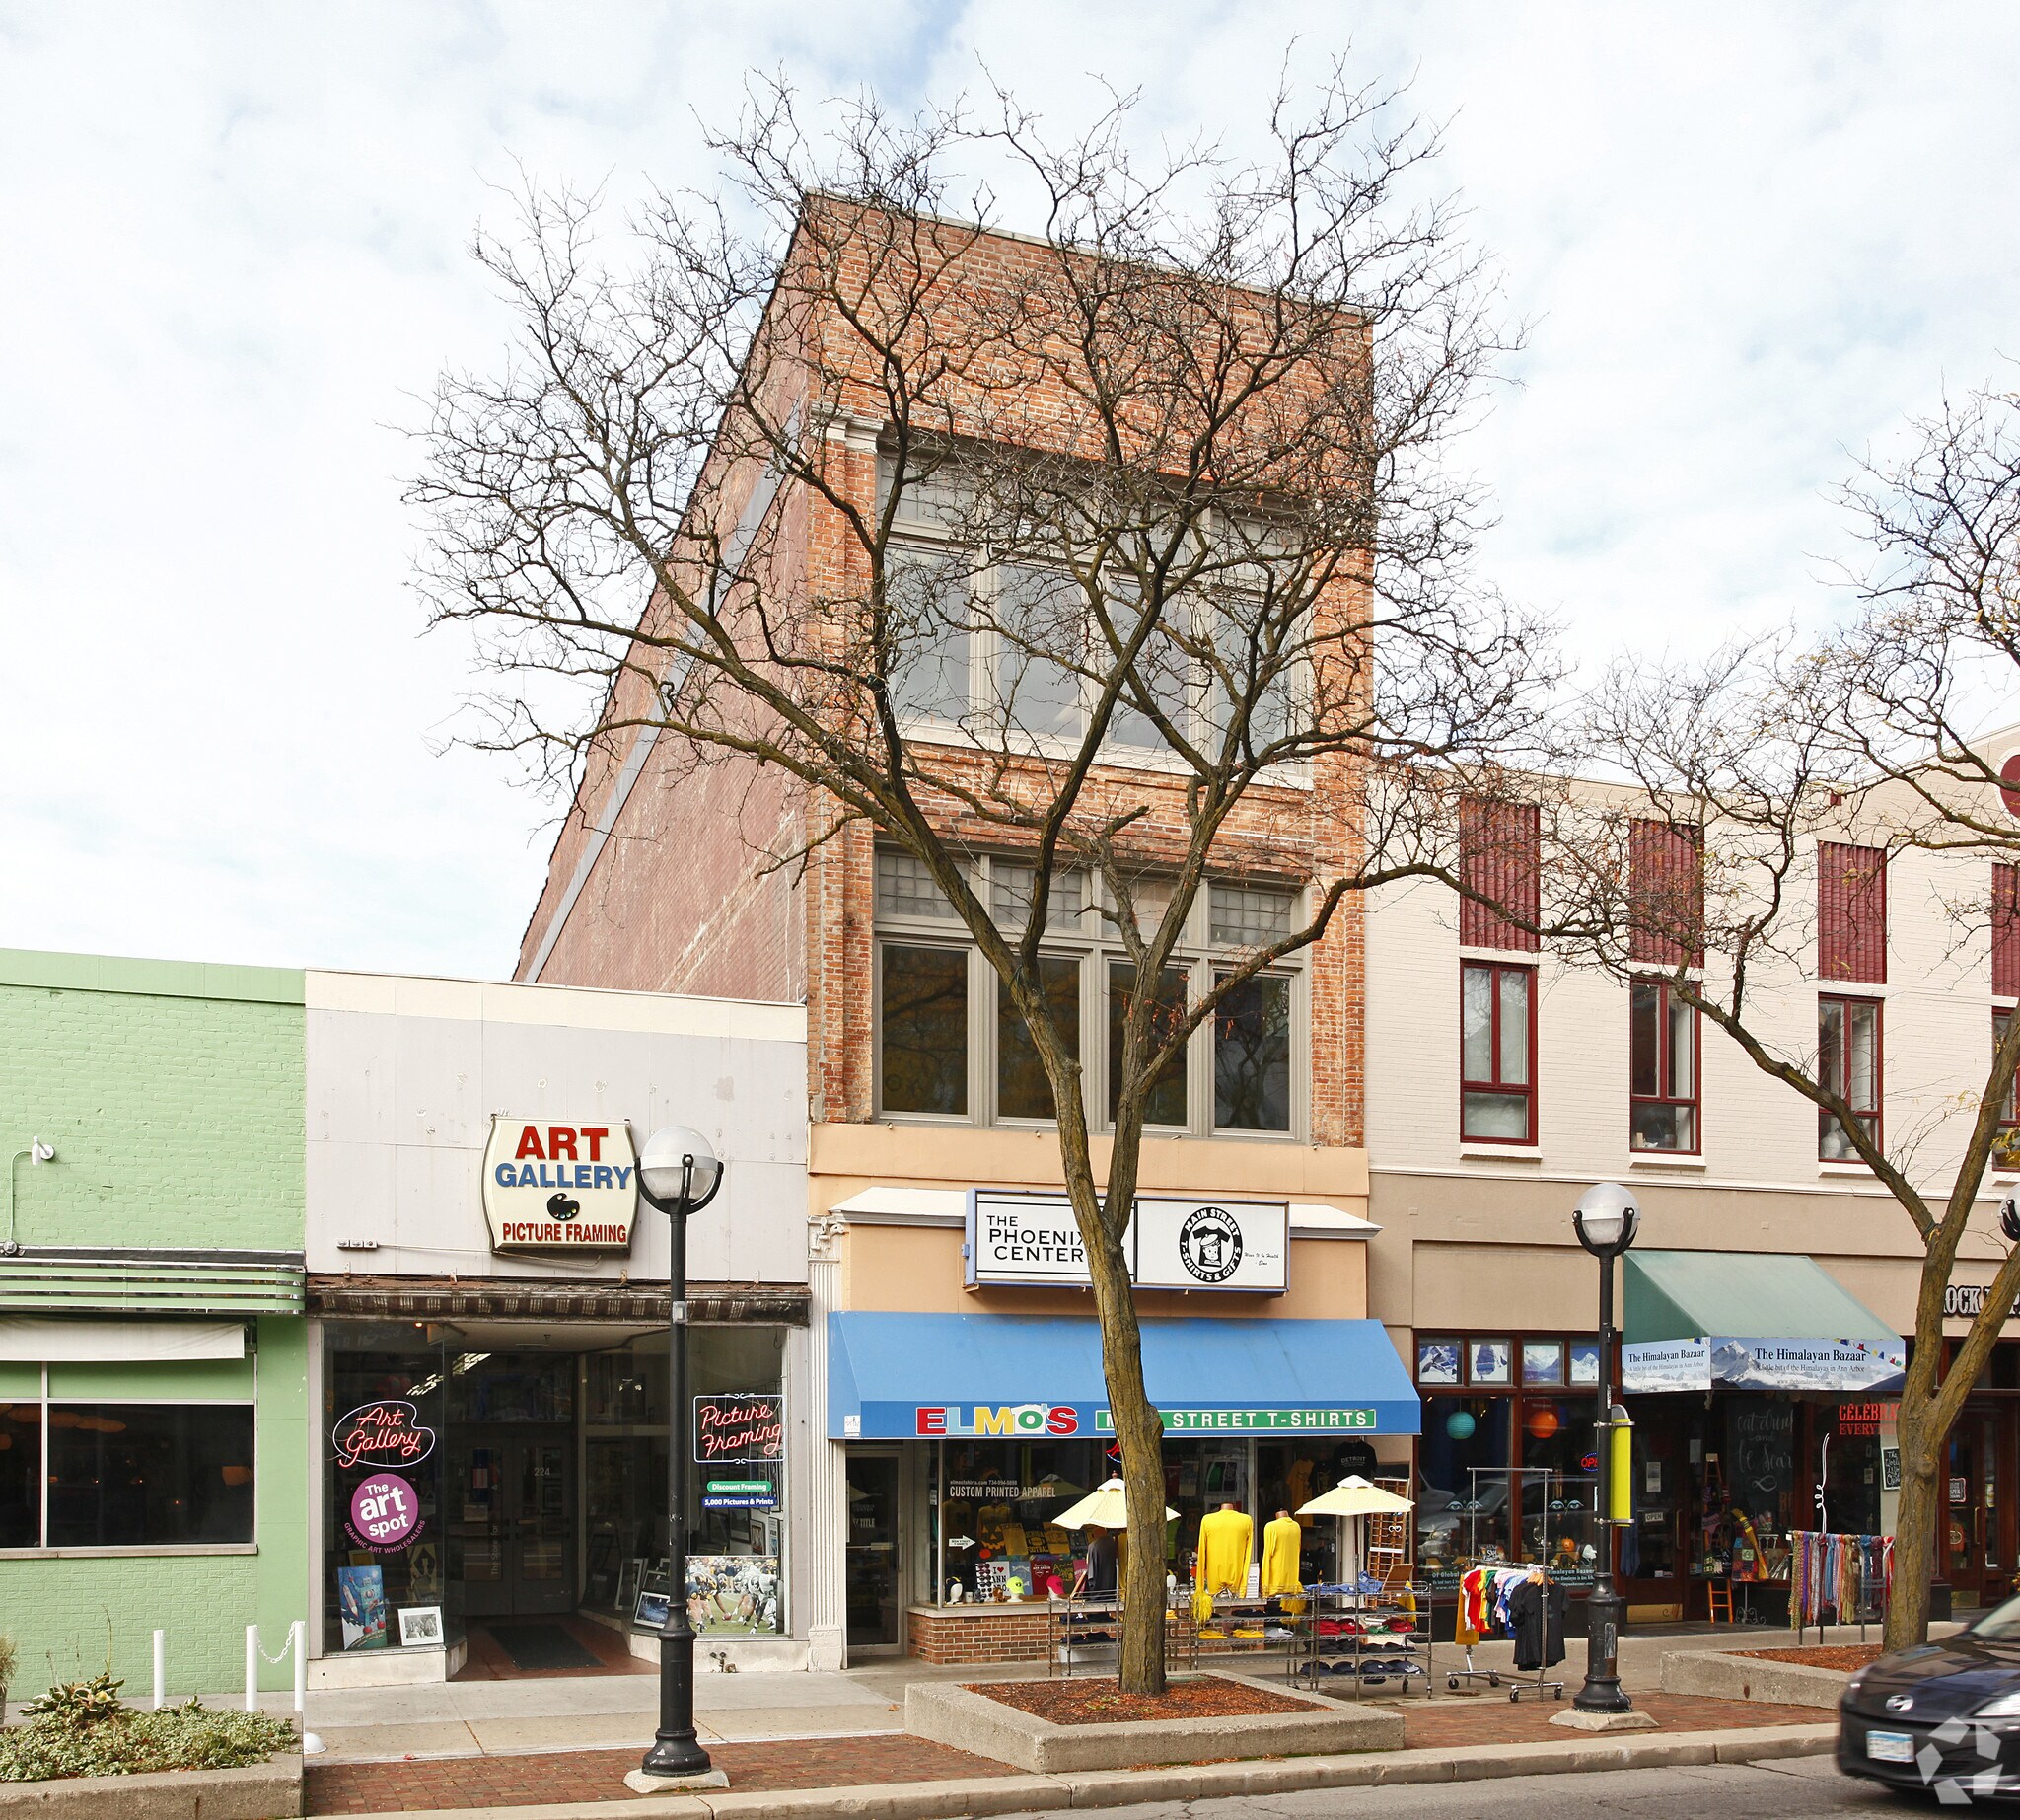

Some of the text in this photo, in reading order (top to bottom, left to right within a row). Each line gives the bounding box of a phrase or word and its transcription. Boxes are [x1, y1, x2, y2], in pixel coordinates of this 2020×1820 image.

[515, 1125, 608, 1161] ART
[495, 1163, 633, 1189] GALLERY
[503, 1223, 626, 1242] PICTURE FRAMING
[987, 1215, 1018, 1227] THE
[1184, 1209, 1239, 1236] MAIN STREET
[994, 1245, 1083, 1262] CENTER
[1181, 1240, 1241, 1281] T-SHIRTS & GIFTS
[1944, 1287, 1980, 1313] OCK
[1628, 1349, 1705, 1363] The Himalayan Bazaar
[1755, 1348, 1866, 1363] The Himalayan Bazaar
[356, 1406, 405, 1426] Art
[700, 1404, 773, 1430] Picture
[916, 1402, 1078, 1436] ELMO'S
[1173, 1412, 1367, 1428] STREET T-SHIRTS
[339, 1428, 422, 1468] Gallery
[702, 1424, 782, 1458] Framing
[534, 1467, 551, 1477] 224
[365, 1483, 389, 1496] The
[950, 1486, 1056, 1498] CUSTOM PRINTED APPAREL
[360, 1485, 407, 1521] art
[344, 1522, 367, 1549] GRAPHIC
[384, 1520, 426, 1553] WHOLESALERS
[368, 1513, 409, 1538] spot
